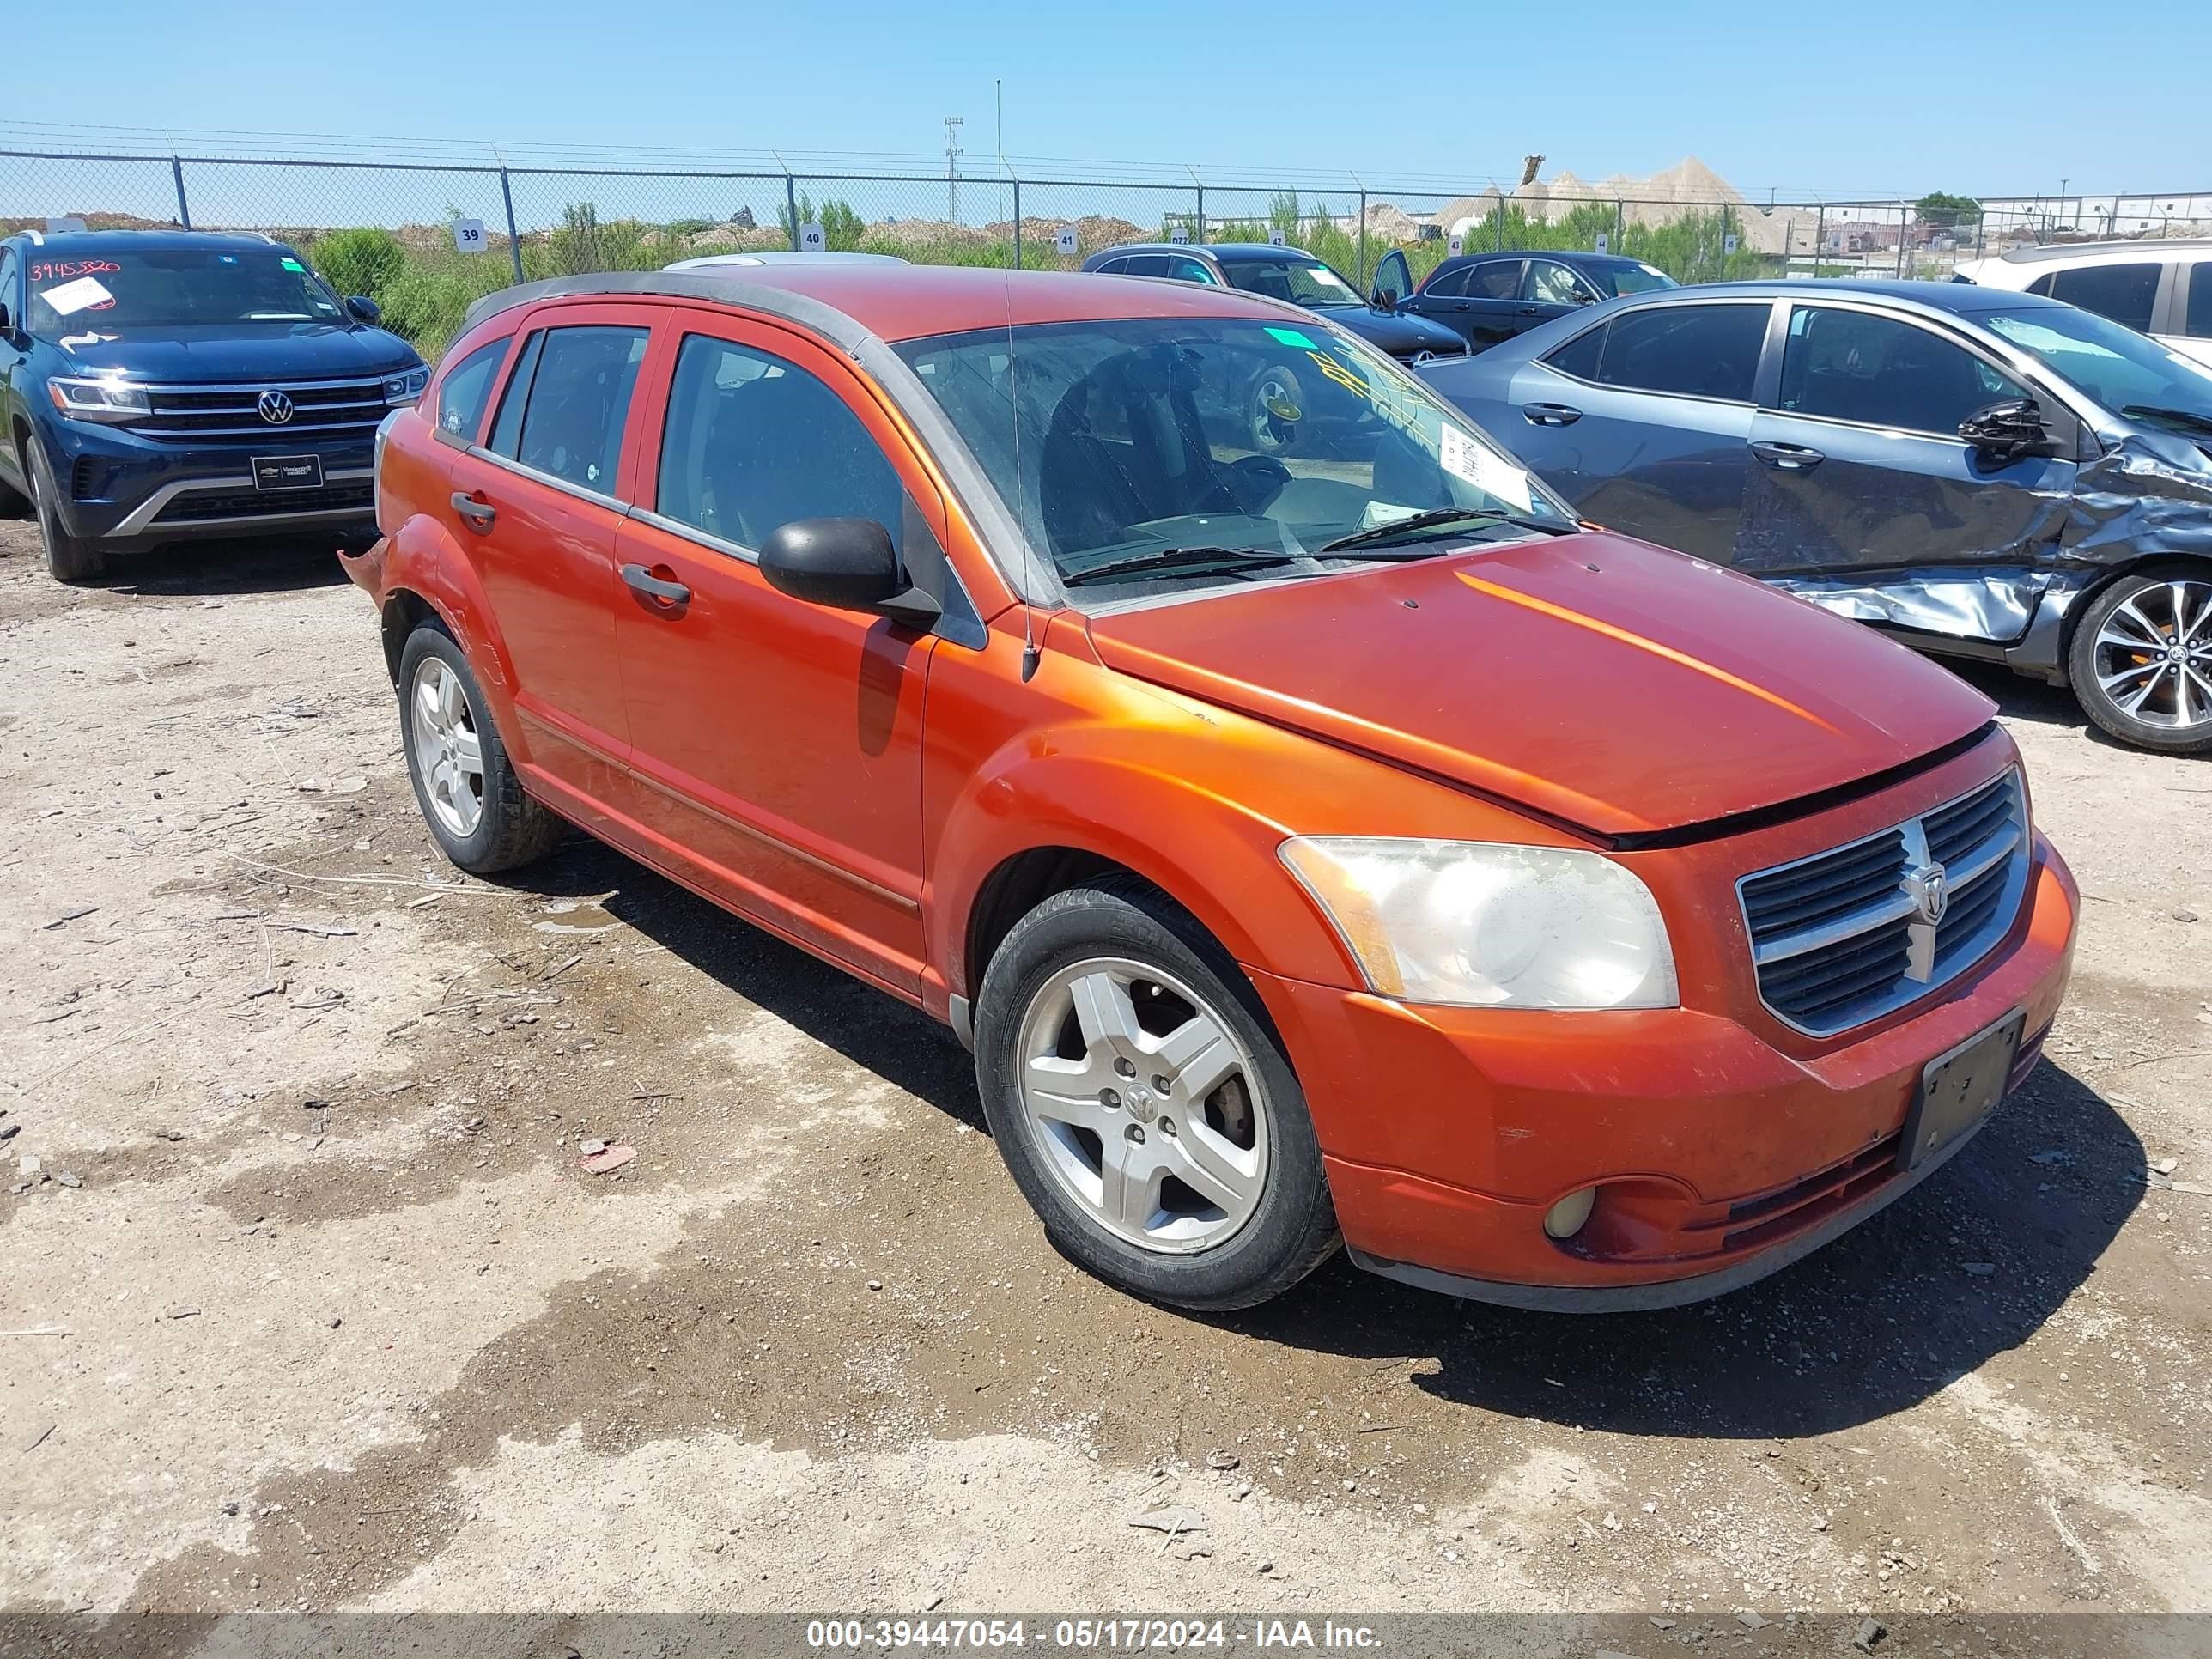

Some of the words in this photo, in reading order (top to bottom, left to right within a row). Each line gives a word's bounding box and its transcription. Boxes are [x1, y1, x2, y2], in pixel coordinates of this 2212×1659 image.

[462, 229, 479, 241] 39
[806, 233, 820, 244] 40
[1061, 234, 1073, 246] 41
[1273, 237, 1282, 246] 42
